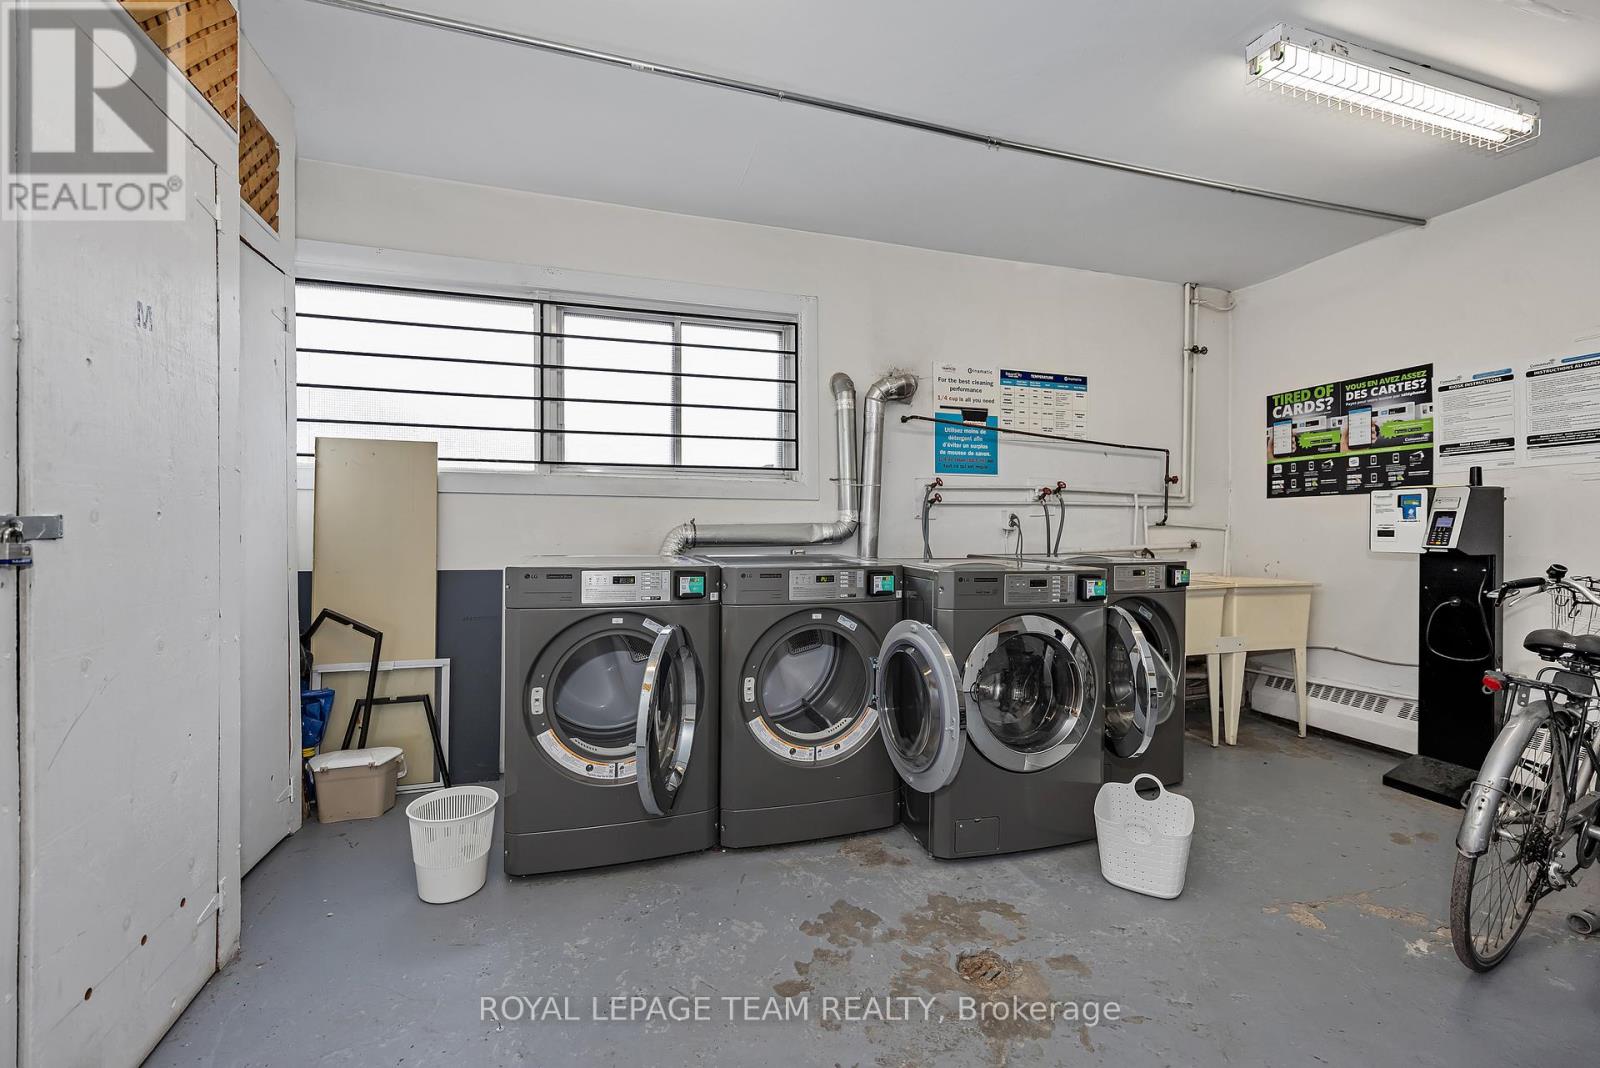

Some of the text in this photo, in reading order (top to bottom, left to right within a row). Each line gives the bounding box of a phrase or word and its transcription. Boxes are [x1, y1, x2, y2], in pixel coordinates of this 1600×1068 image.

[1345, 382, 1367, 391] VOUS
[1379, 375, 1400, 385] AVEZ
[1401, 370, 1427, 380] ASSEZ
[1533, 364, 1574, 376] INSTRUCTIONS
[949, 386, 983, 394] performance
[1345, 389, 1368, 402] DES
[1370, 378, 1427, 397] CARTES?
[1464, 377, 1502, 388] INSTRUCTIONS
[1271, 384, 1335, 407] TIRED OF
[1272, 396, 1335, 419] CARDS?
